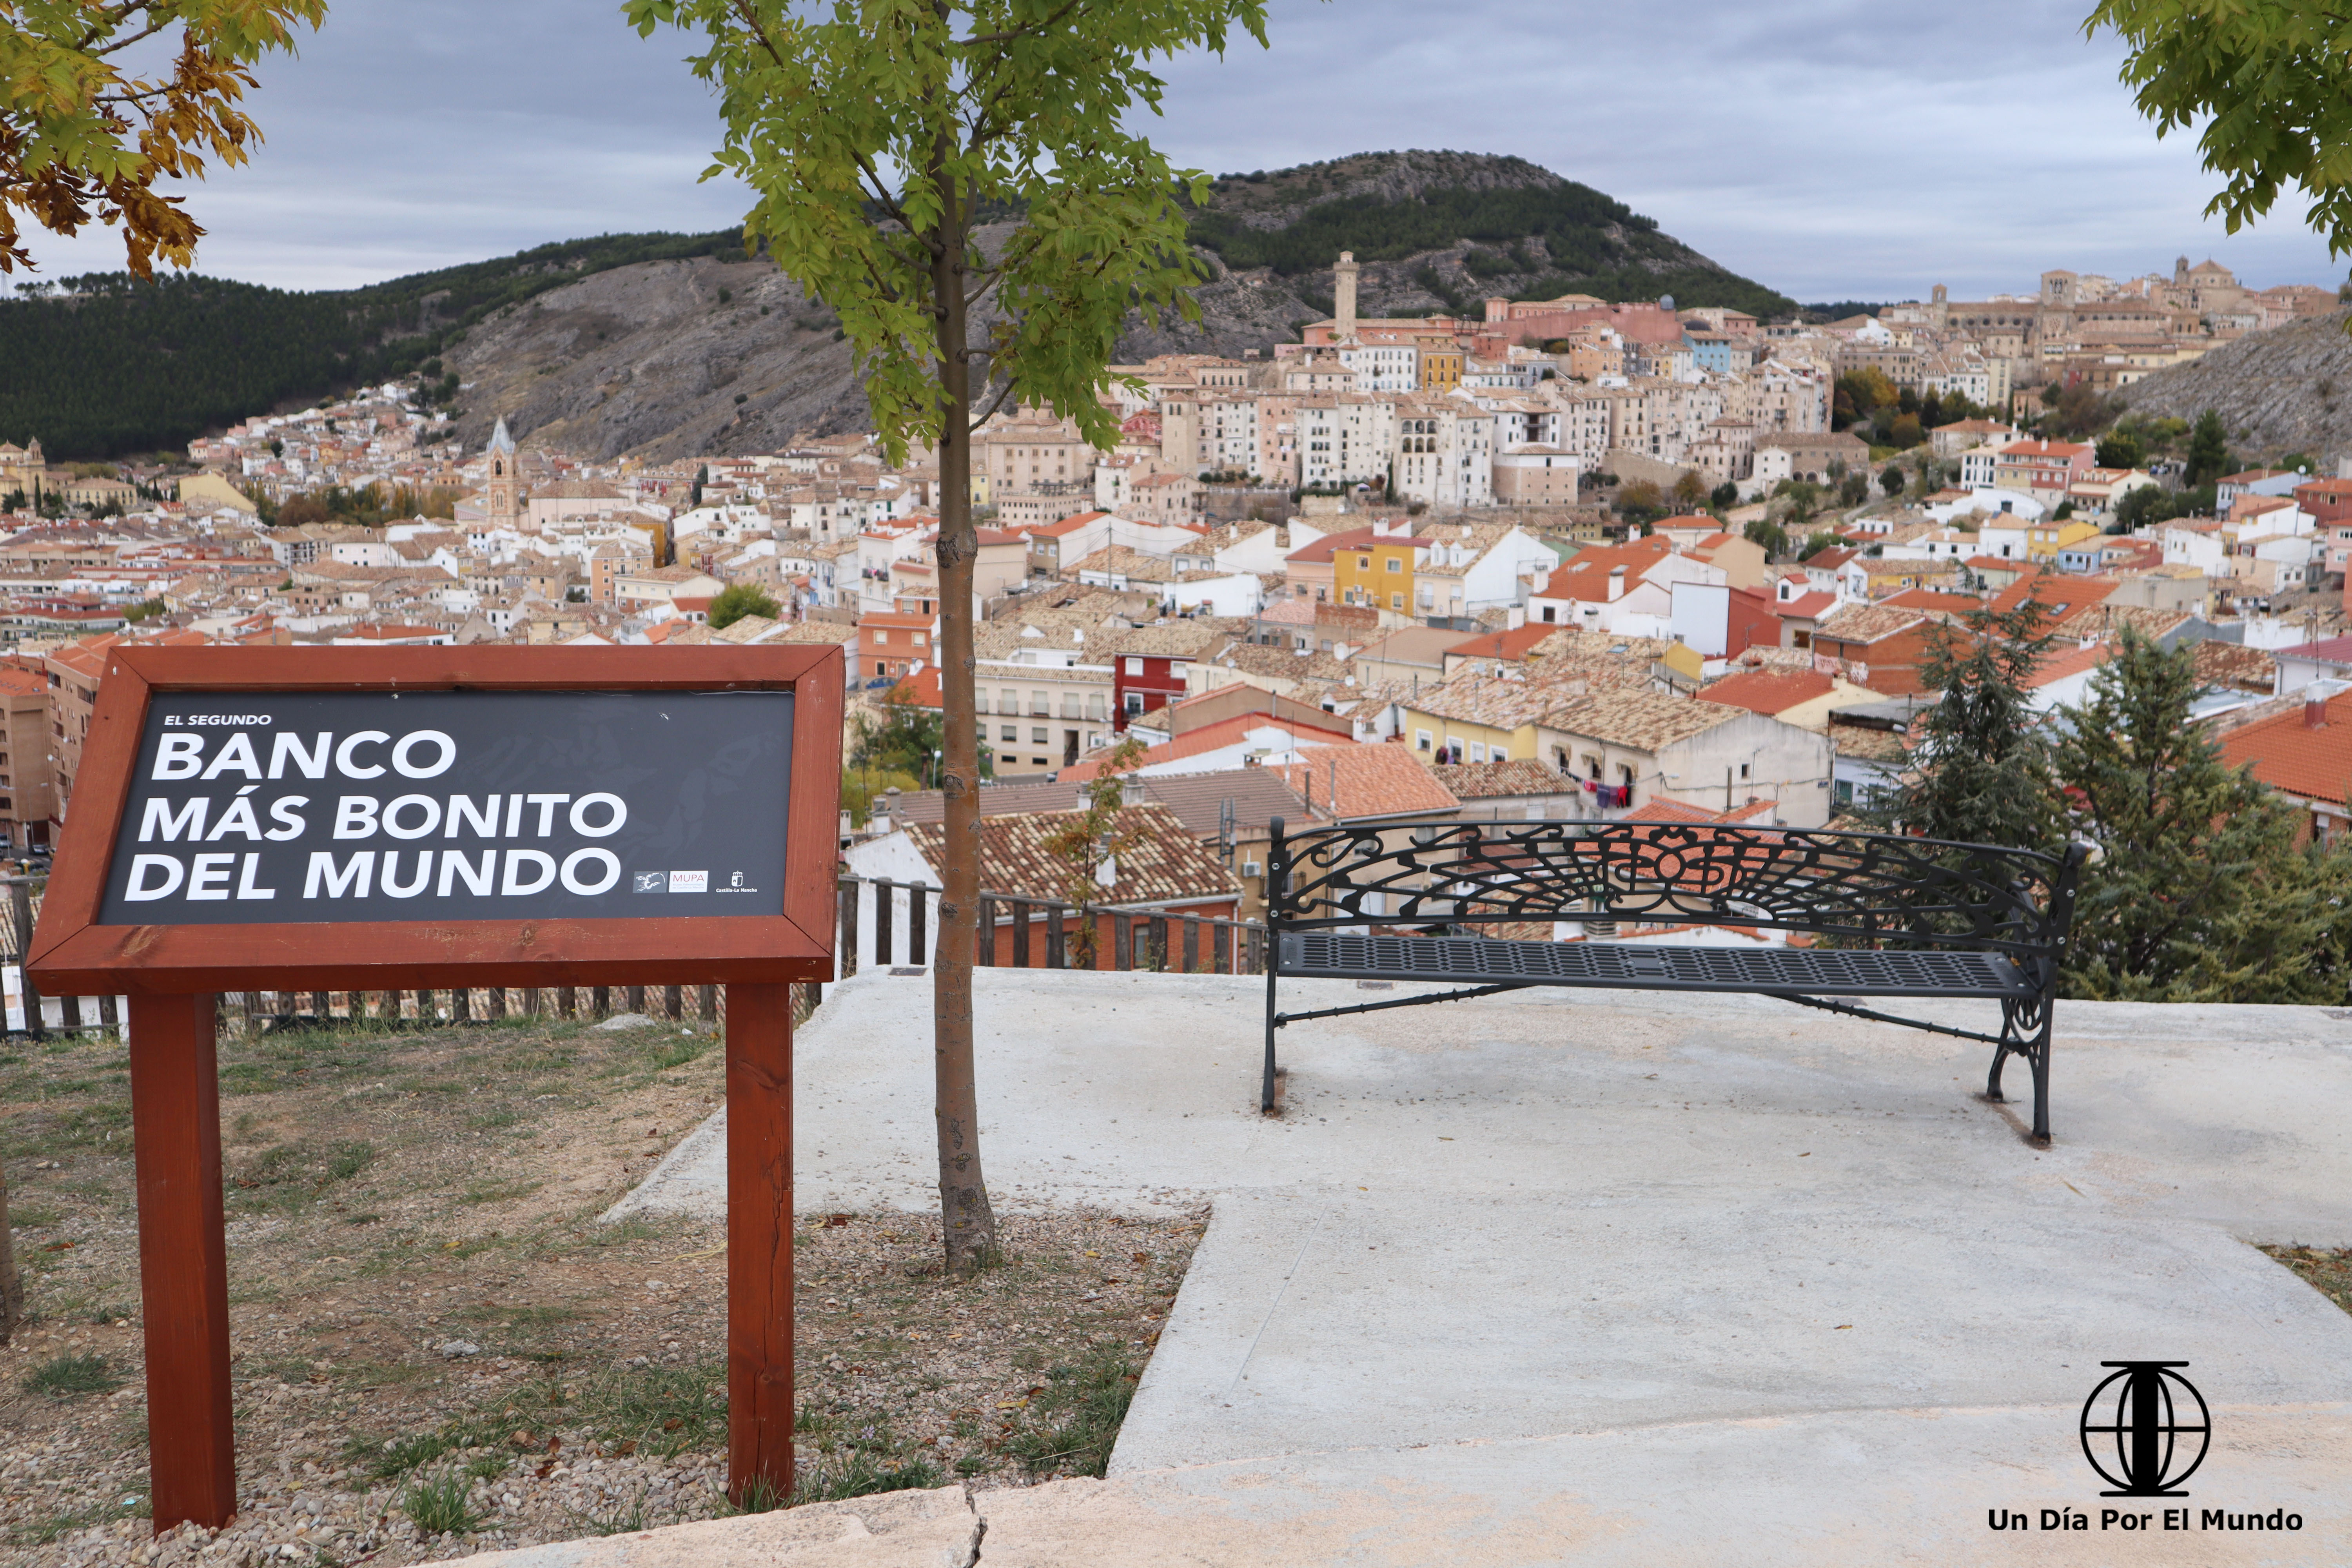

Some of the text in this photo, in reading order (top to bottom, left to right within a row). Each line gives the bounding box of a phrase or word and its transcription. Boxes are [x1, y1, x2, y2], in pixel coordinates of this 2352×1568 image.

[164, 715, 272, 725] EL SEGUNDO
[151, 730, 456, 780] BANCO
[138, 785, 627, 842] MÁS BONITO
[124, 847, 621, 901] DEL MUNDO
